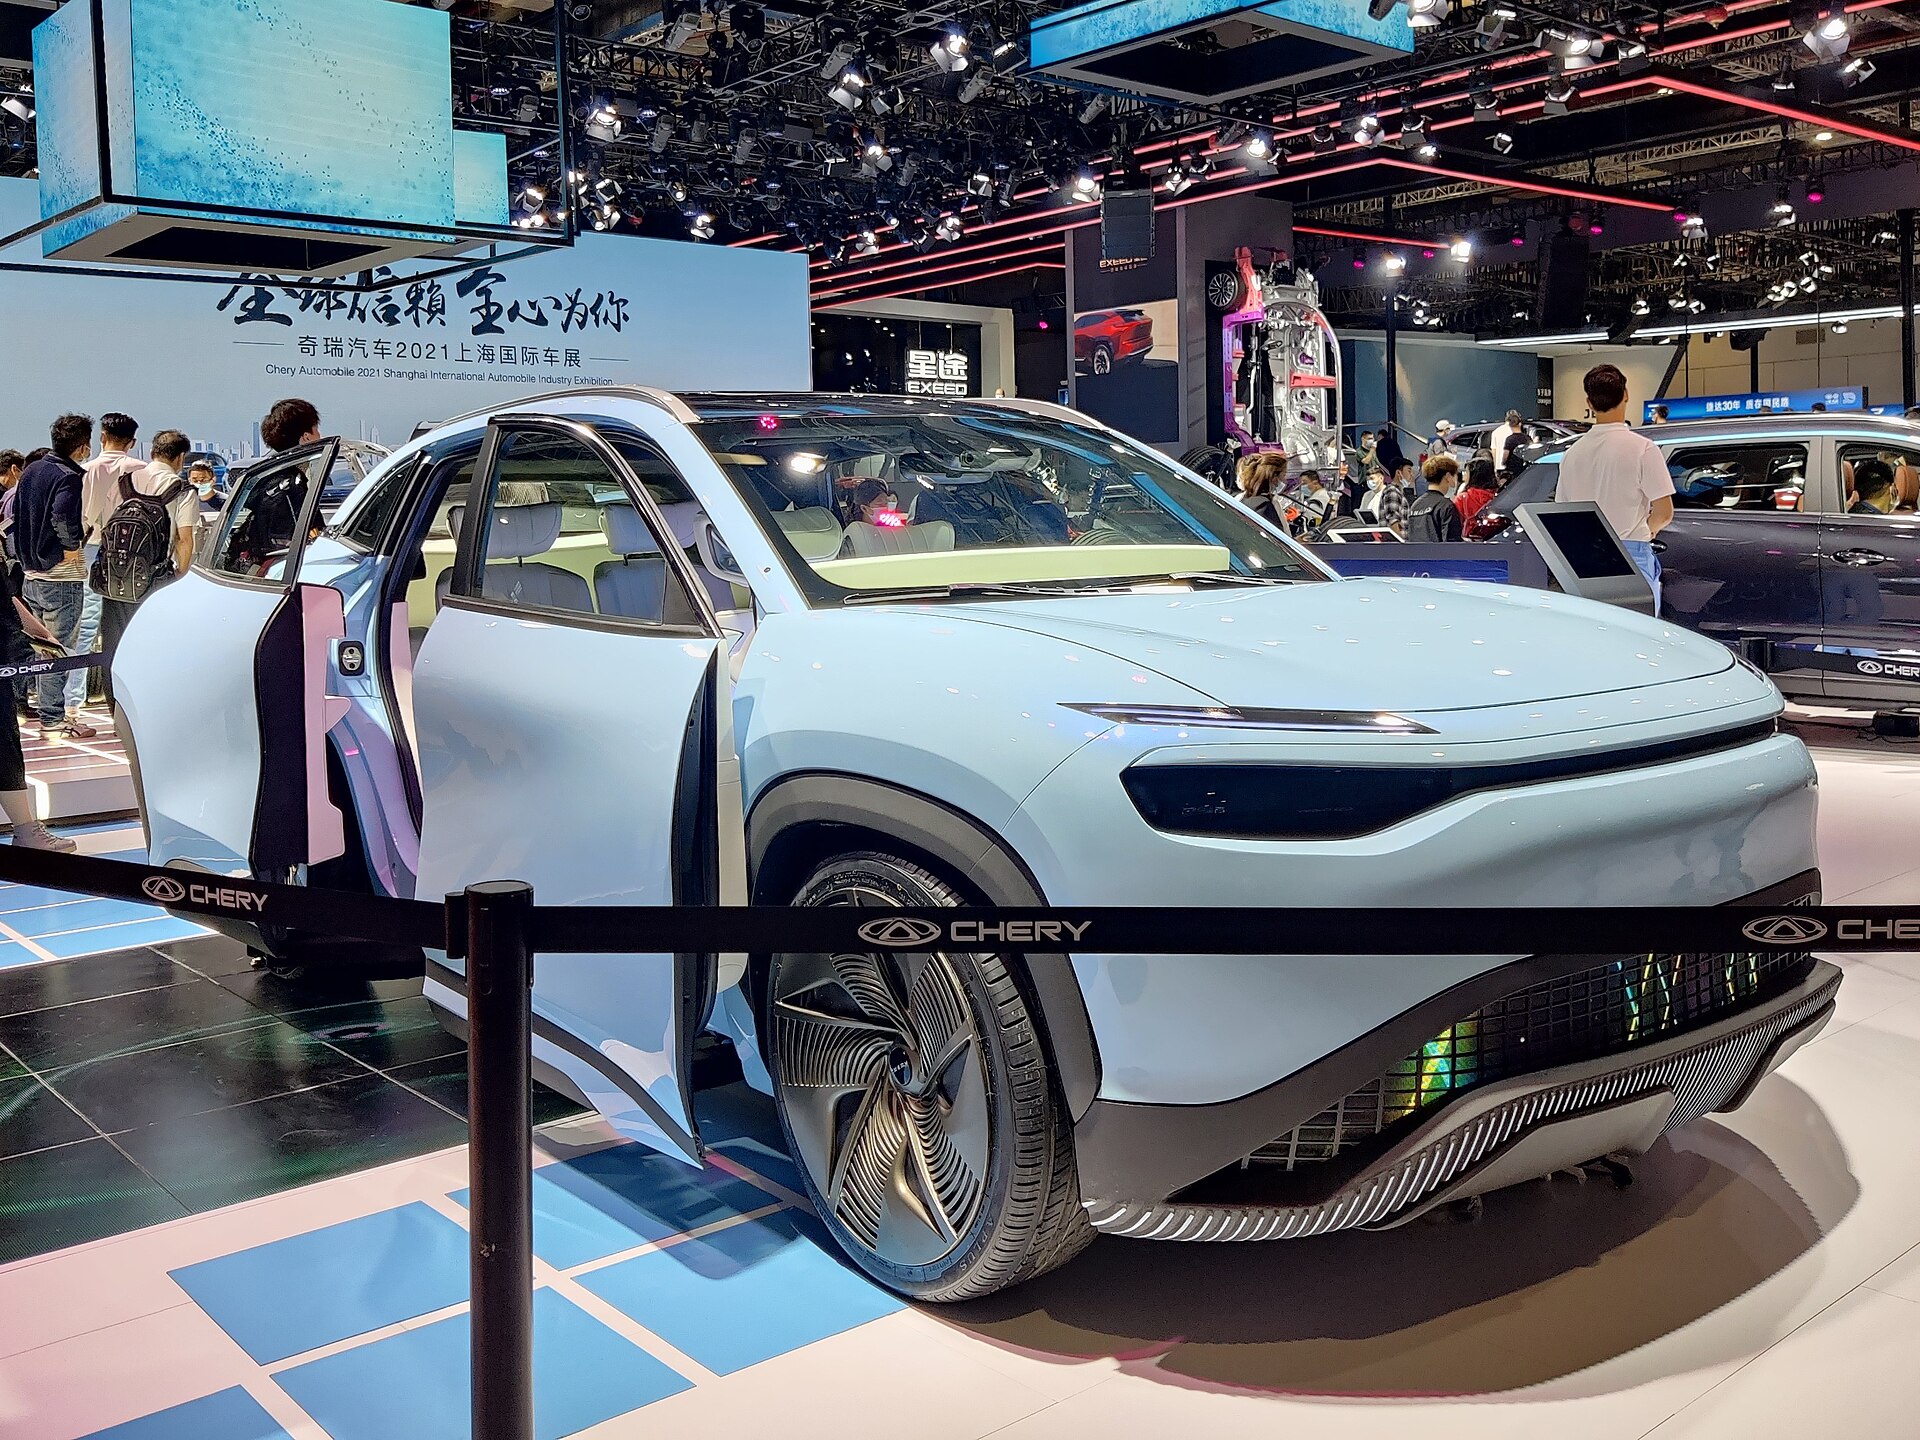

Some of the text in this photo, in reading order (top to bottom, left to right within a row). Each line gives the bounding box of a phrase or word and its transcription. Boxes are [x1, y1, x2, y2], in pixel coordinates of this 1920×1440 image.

[298, 335, 581, 368] 奇瑞汽车2021上海国际车展
[265, 364, 613, 387] Chery Automobile 2021 Shanghai International Automobile Industry Exhibition
[908, 350, 968, 381] 星途
[907, 381, 968, 395] EXEED
[18, 662, 55, 674] CHERY
[189, 884, 268, 912] CHERY
[950, 921, 1092, 942] CHERY
